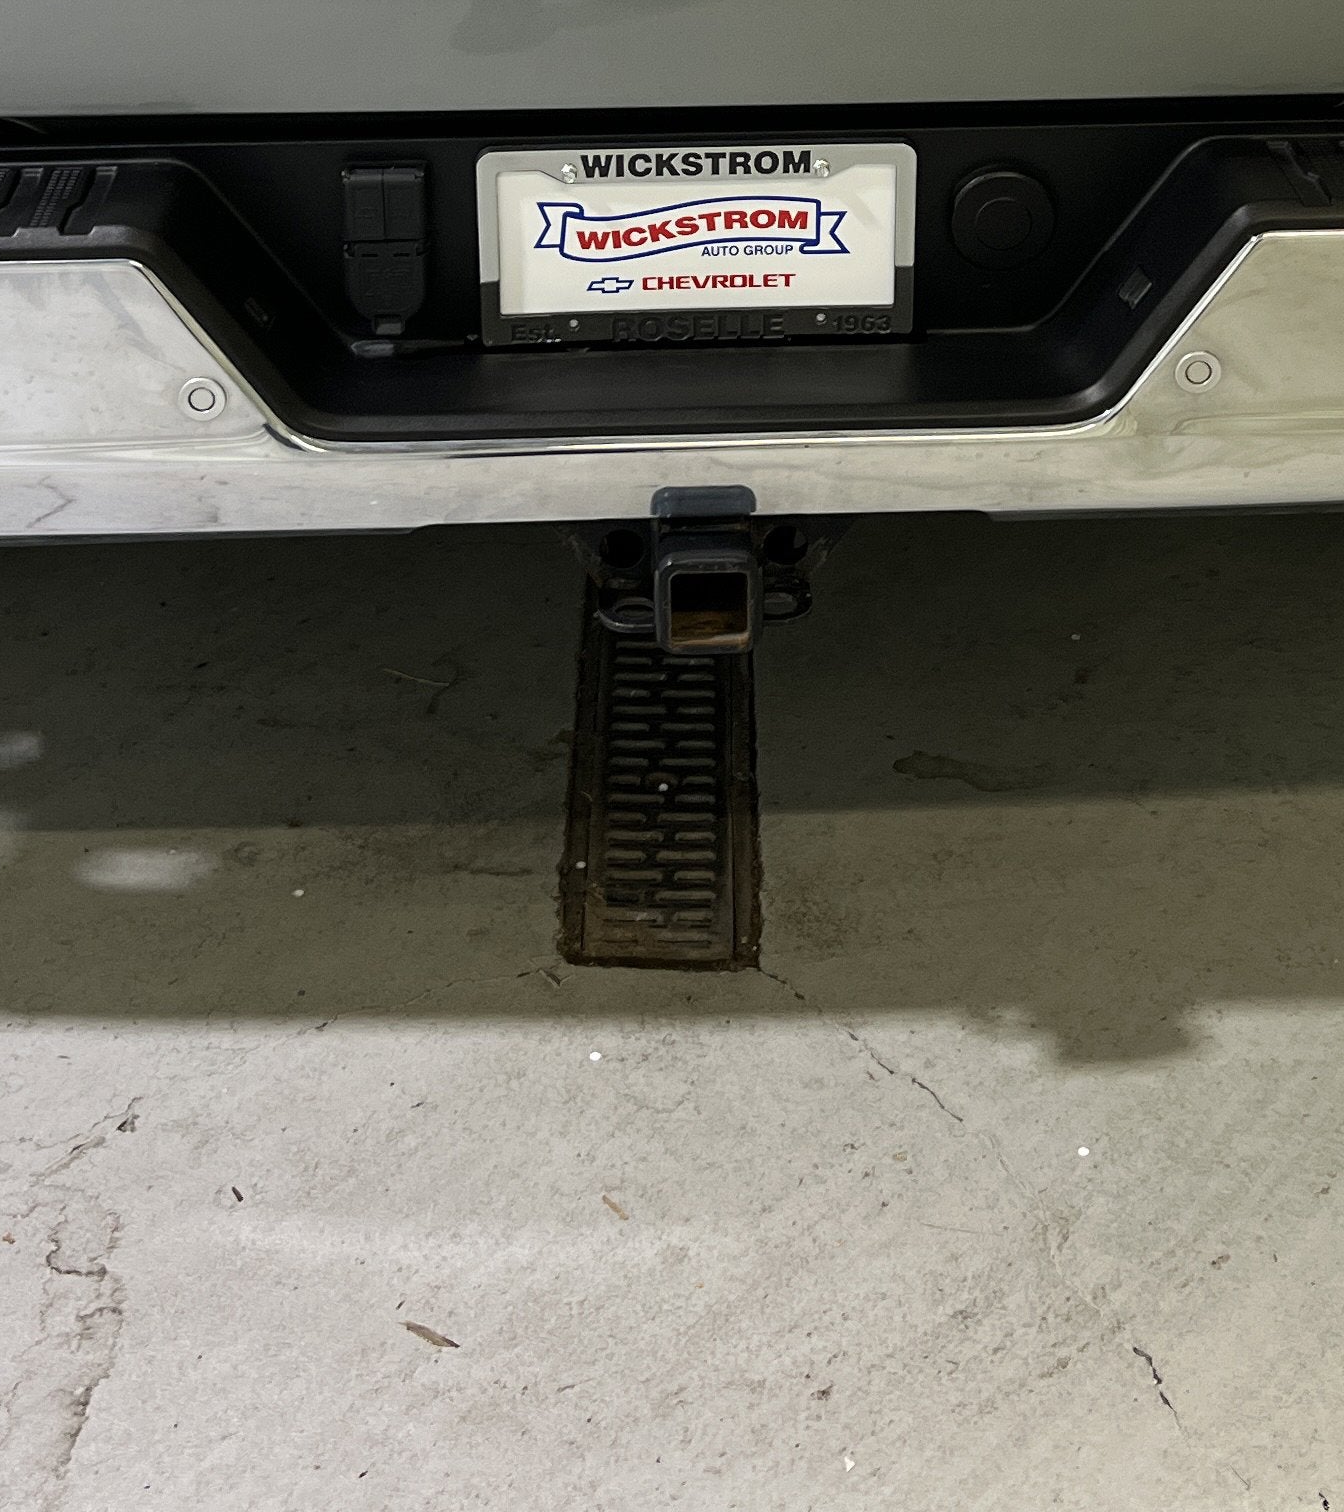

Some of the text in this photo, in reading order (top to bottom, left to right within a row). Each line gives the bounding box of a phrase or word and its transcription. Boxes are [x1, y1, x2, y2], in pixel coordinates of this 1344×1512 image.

[580, 150, 812, 178] WICKSTROM
[576, 209, 809, 250] WICKSTROM
[701, 244, 794, 257] AUTO GROUP
[642, 273, 796, 291] CHEVROLET
[612, 313, 785, 343] ROSELLE
[832, 314, 892, 334] 1963
